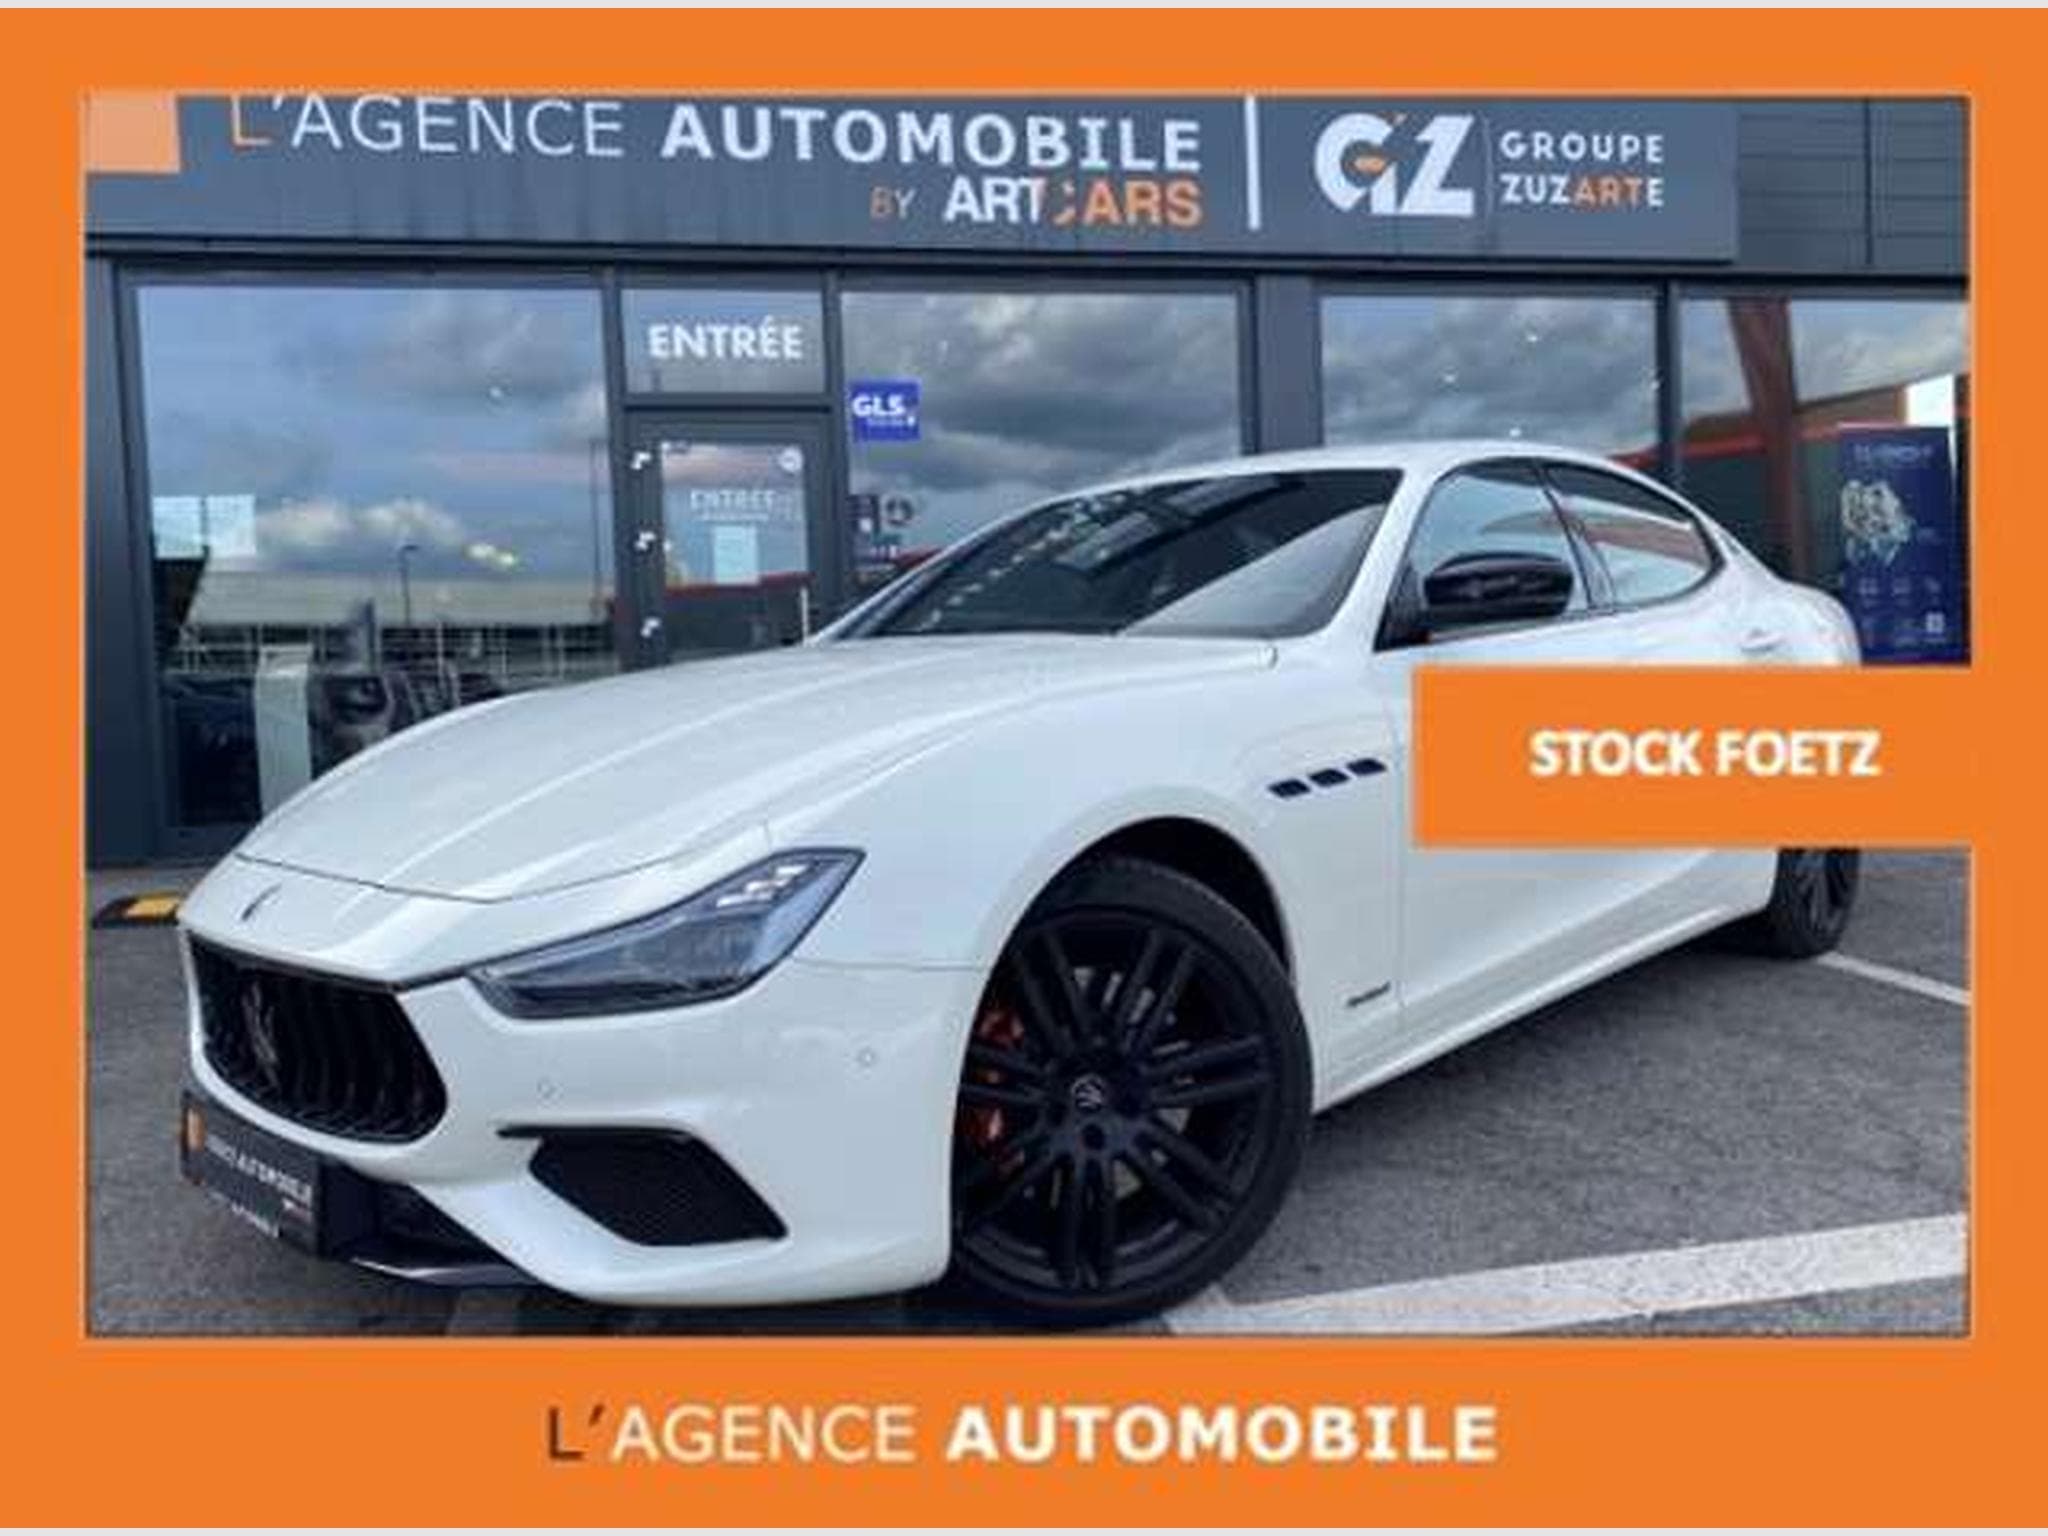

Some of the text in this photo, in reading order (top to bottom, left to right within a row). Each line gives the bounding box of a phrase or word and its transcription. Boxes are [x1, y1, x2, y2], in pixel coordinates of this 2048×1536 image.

[231, 92, 1201, 172] L'AGENCE AUTOMOBILE
[1501, 131, 1664, 163] GROUPE
[869, 186, 914, 220] BY
[1501, 173, 1664, 208] ZUZARTE
[648, 315, 804, 359] ENTRÉE
[852, 393, 907, 417] GLS
